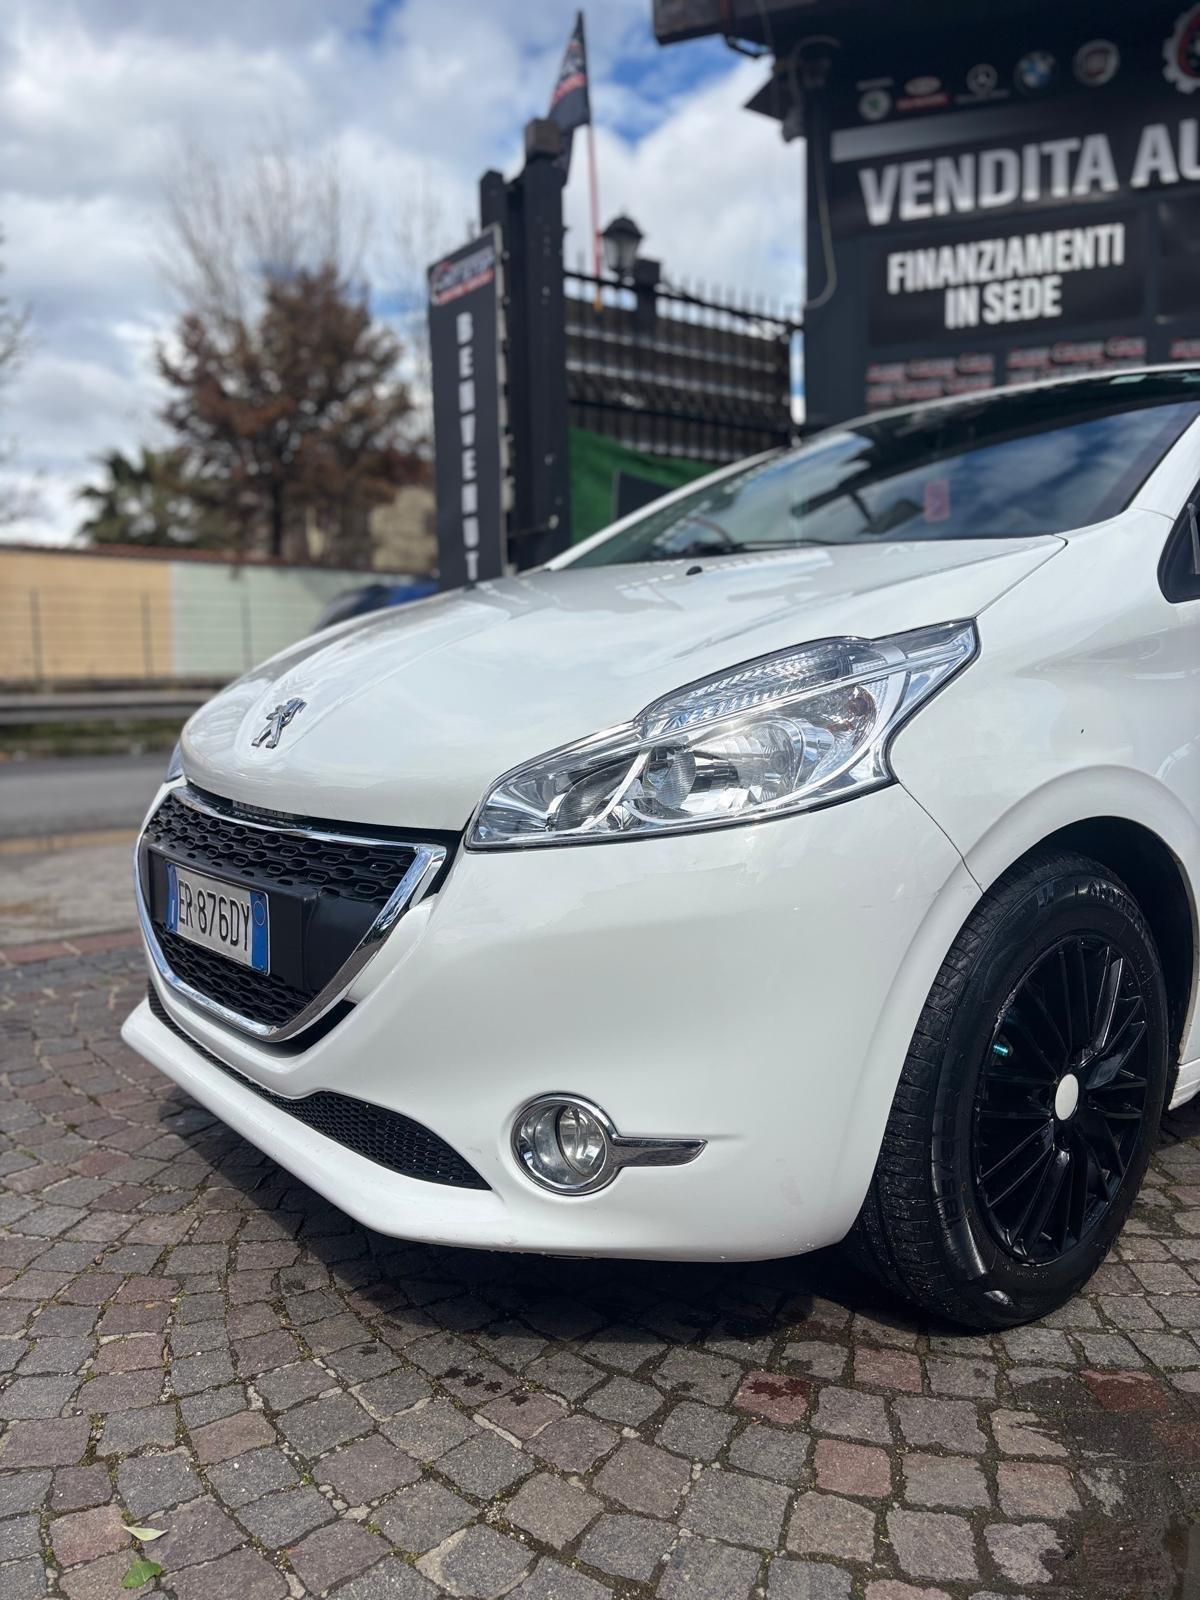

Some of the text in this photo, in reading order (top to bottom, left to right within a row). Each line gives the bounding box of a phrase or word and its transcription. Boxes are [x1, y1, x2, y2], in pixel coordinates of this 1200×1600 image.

[858, 133, 1119, 226] VENDITA
[887, 222, 1125, 295] FINANZIAMENTI
[944, 274, 1063, 330] IN SEDE
[178, 880, 250, 952] ER 876DY
